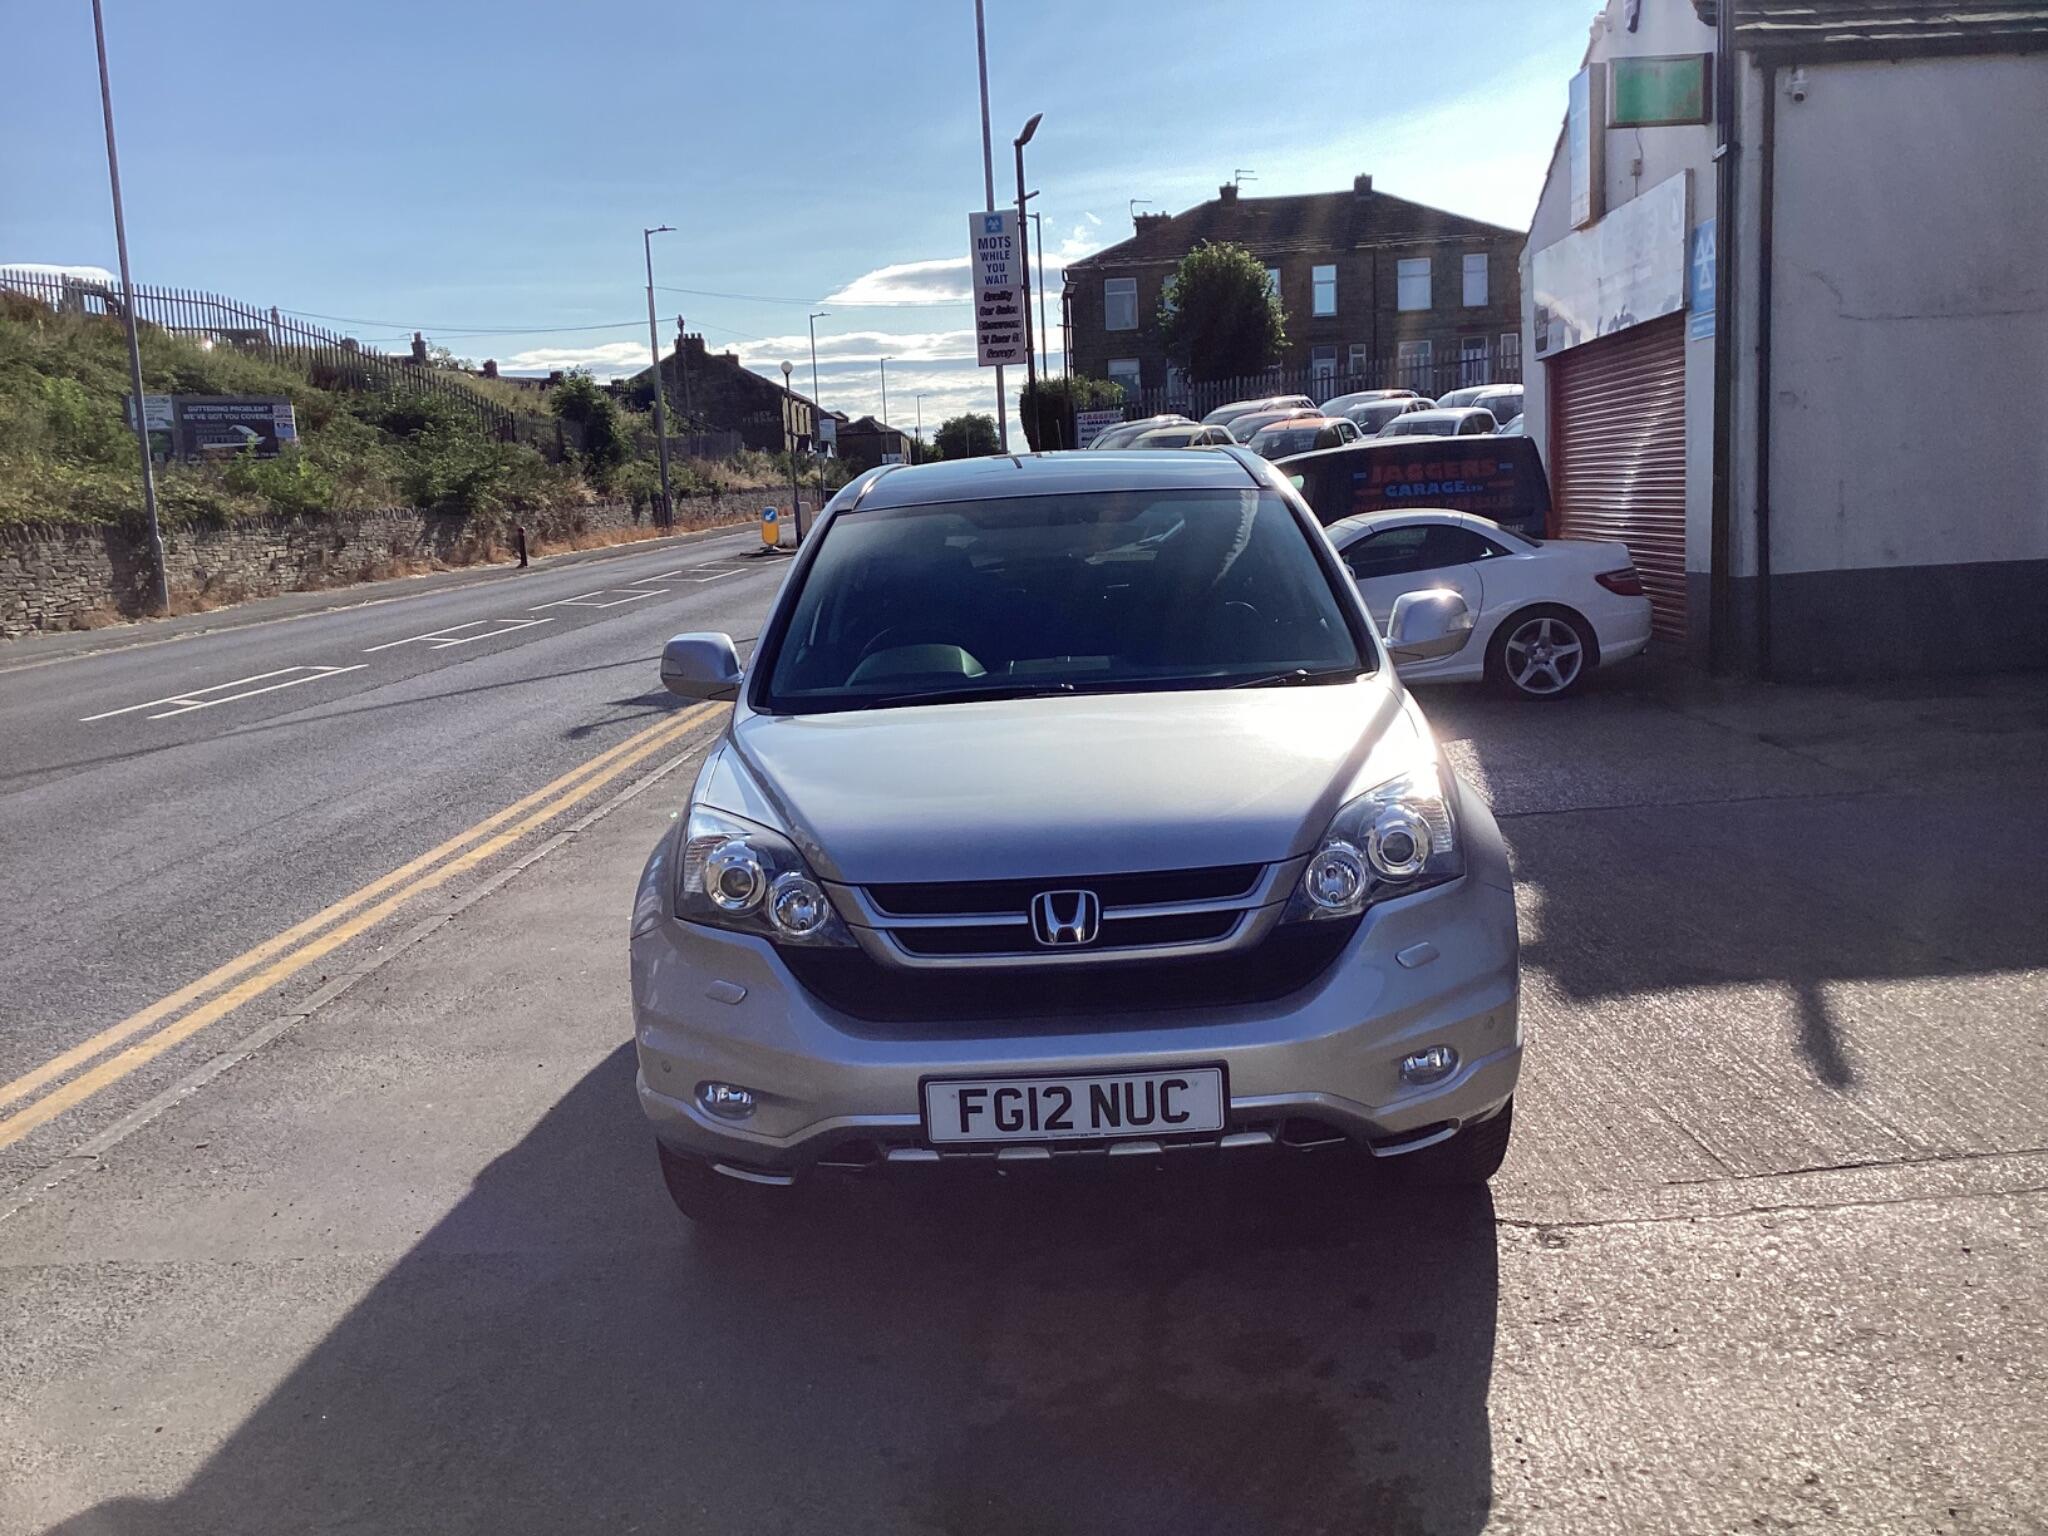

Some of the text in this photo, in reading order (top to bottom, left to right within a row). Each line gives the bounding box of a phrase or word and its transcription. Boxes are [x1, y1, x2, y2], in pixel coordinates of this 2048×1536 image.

[978, 236, 1011, 250] MOTS
[980, 250, 1010, 261] WHILE
[986, 263, 1005, 273] YOU
[984, 274, 1008, 285] WAIT
[1371, 458, 1497, 483] JAGGERS
[1385, 480, 1466, 497] GARAGE
[958, 1079, 1190, 1133] FG12 NUC
